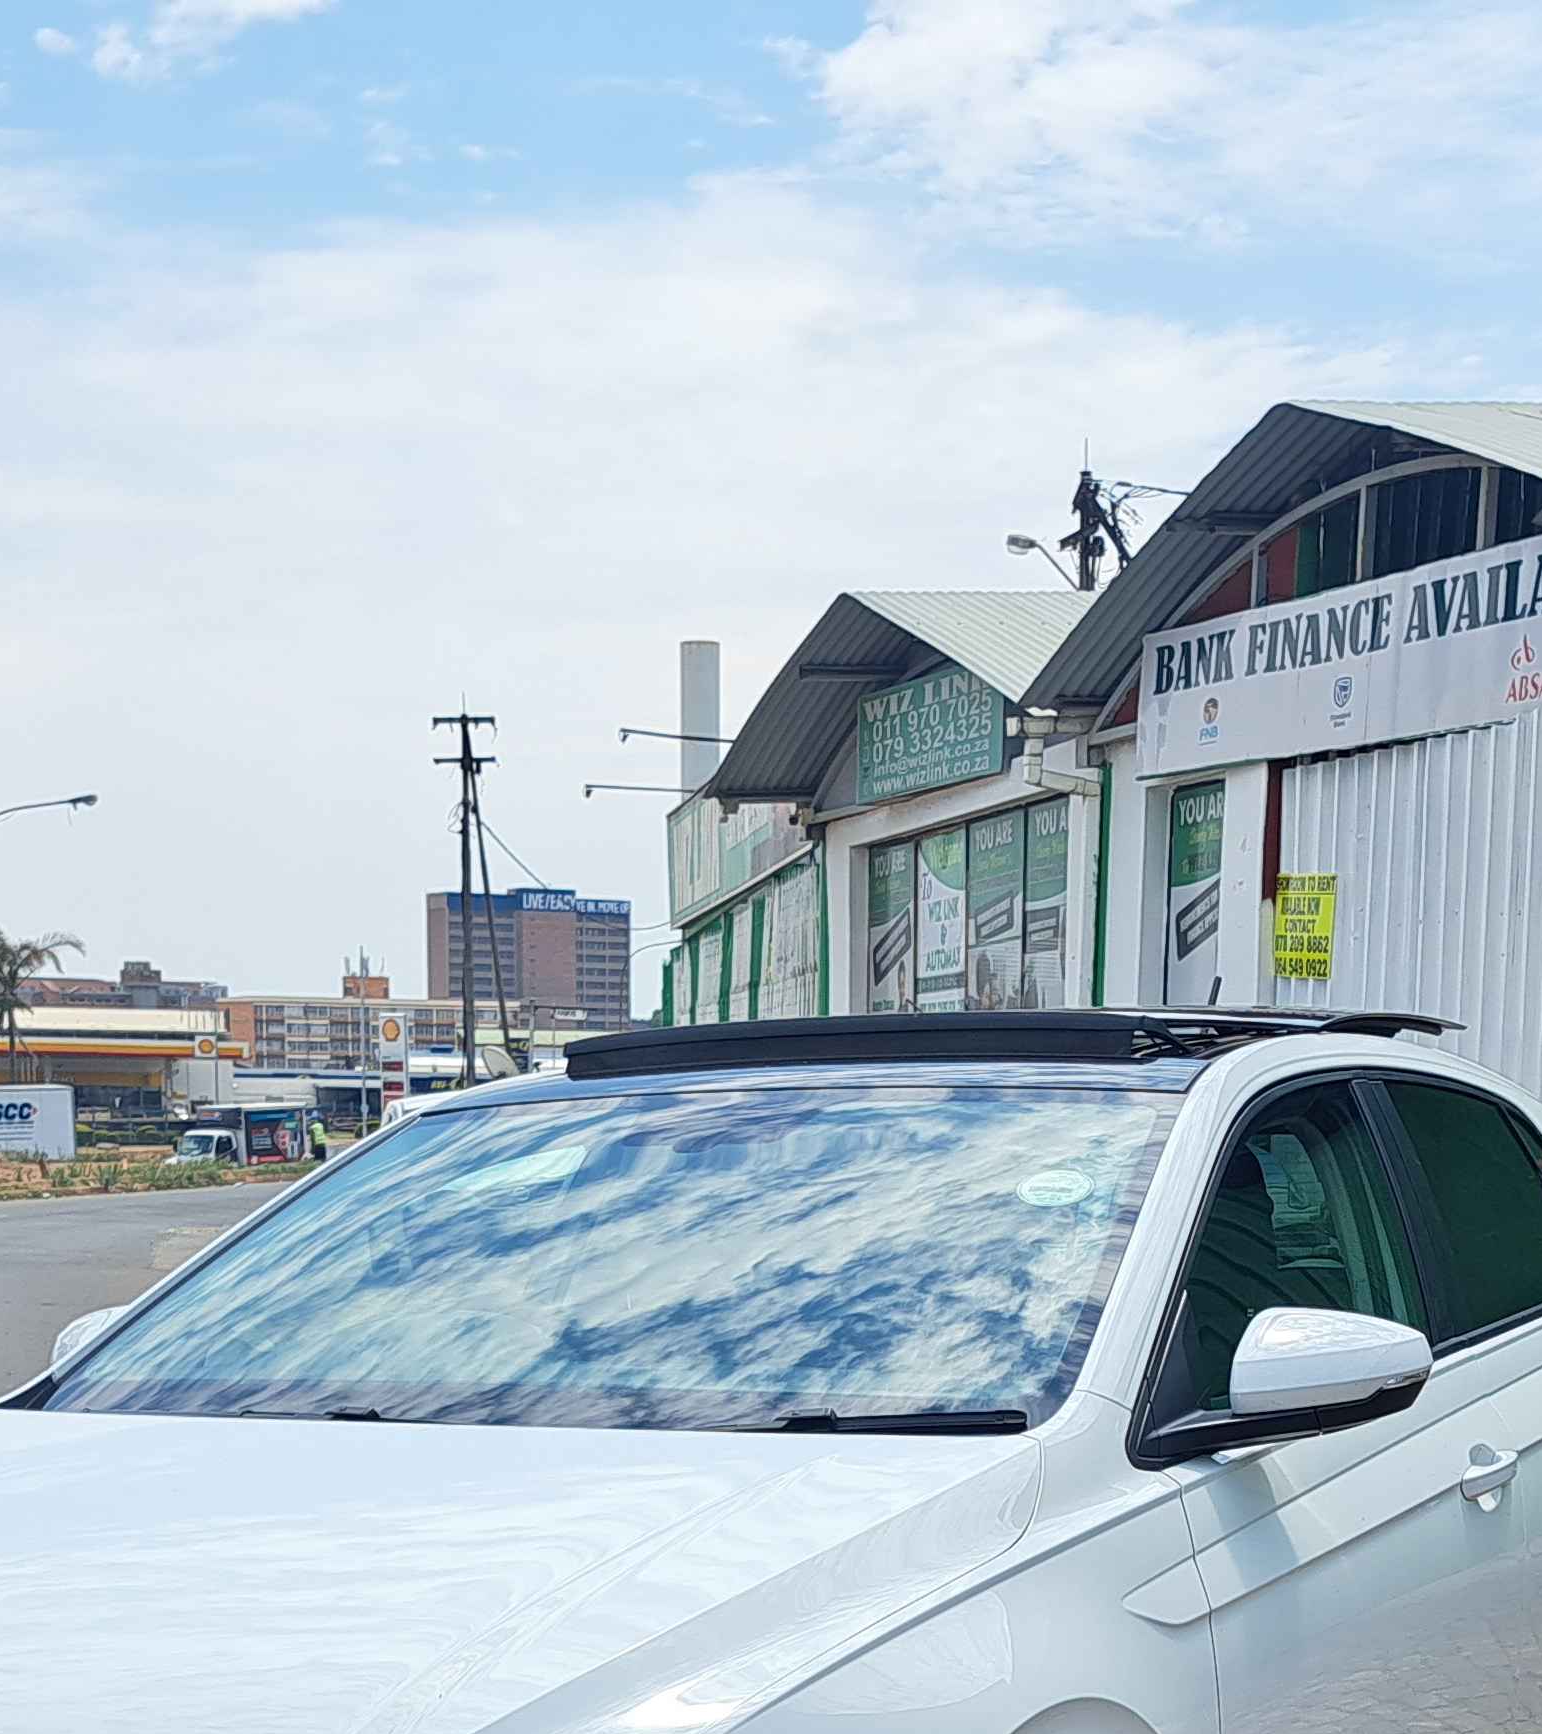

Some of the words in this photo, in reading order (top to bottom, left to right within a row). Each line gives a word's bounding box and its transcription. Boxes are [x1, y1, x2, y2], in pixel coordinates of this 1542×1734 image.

[1153, 628, 1236, 696] BANK
[1244, 591, 1394, 677] FINANCE
[863, 688, 915, 722] WIZ
[872, 715, 901, 742] 011
[907, 704, 940, 732] 970
[945, 690, 993, 722] 7025
[872, 736, 905, 764] 079
[909, 712, 993, 754] 3324325
[1198, 725, 1219, 742] FNB
[873, 739, 990, 778] info@wizlink.co.za
[873, 756, 990, 795] www.wizlink.co.za
[1035, 811, 1058, 837] YOU
[1178, 796, 1206, 826] YOU
[1208, 791, 1224, 821] AR
[975, 825, 996, 852] YOU
[995, 818, 1013, 845] ARE
